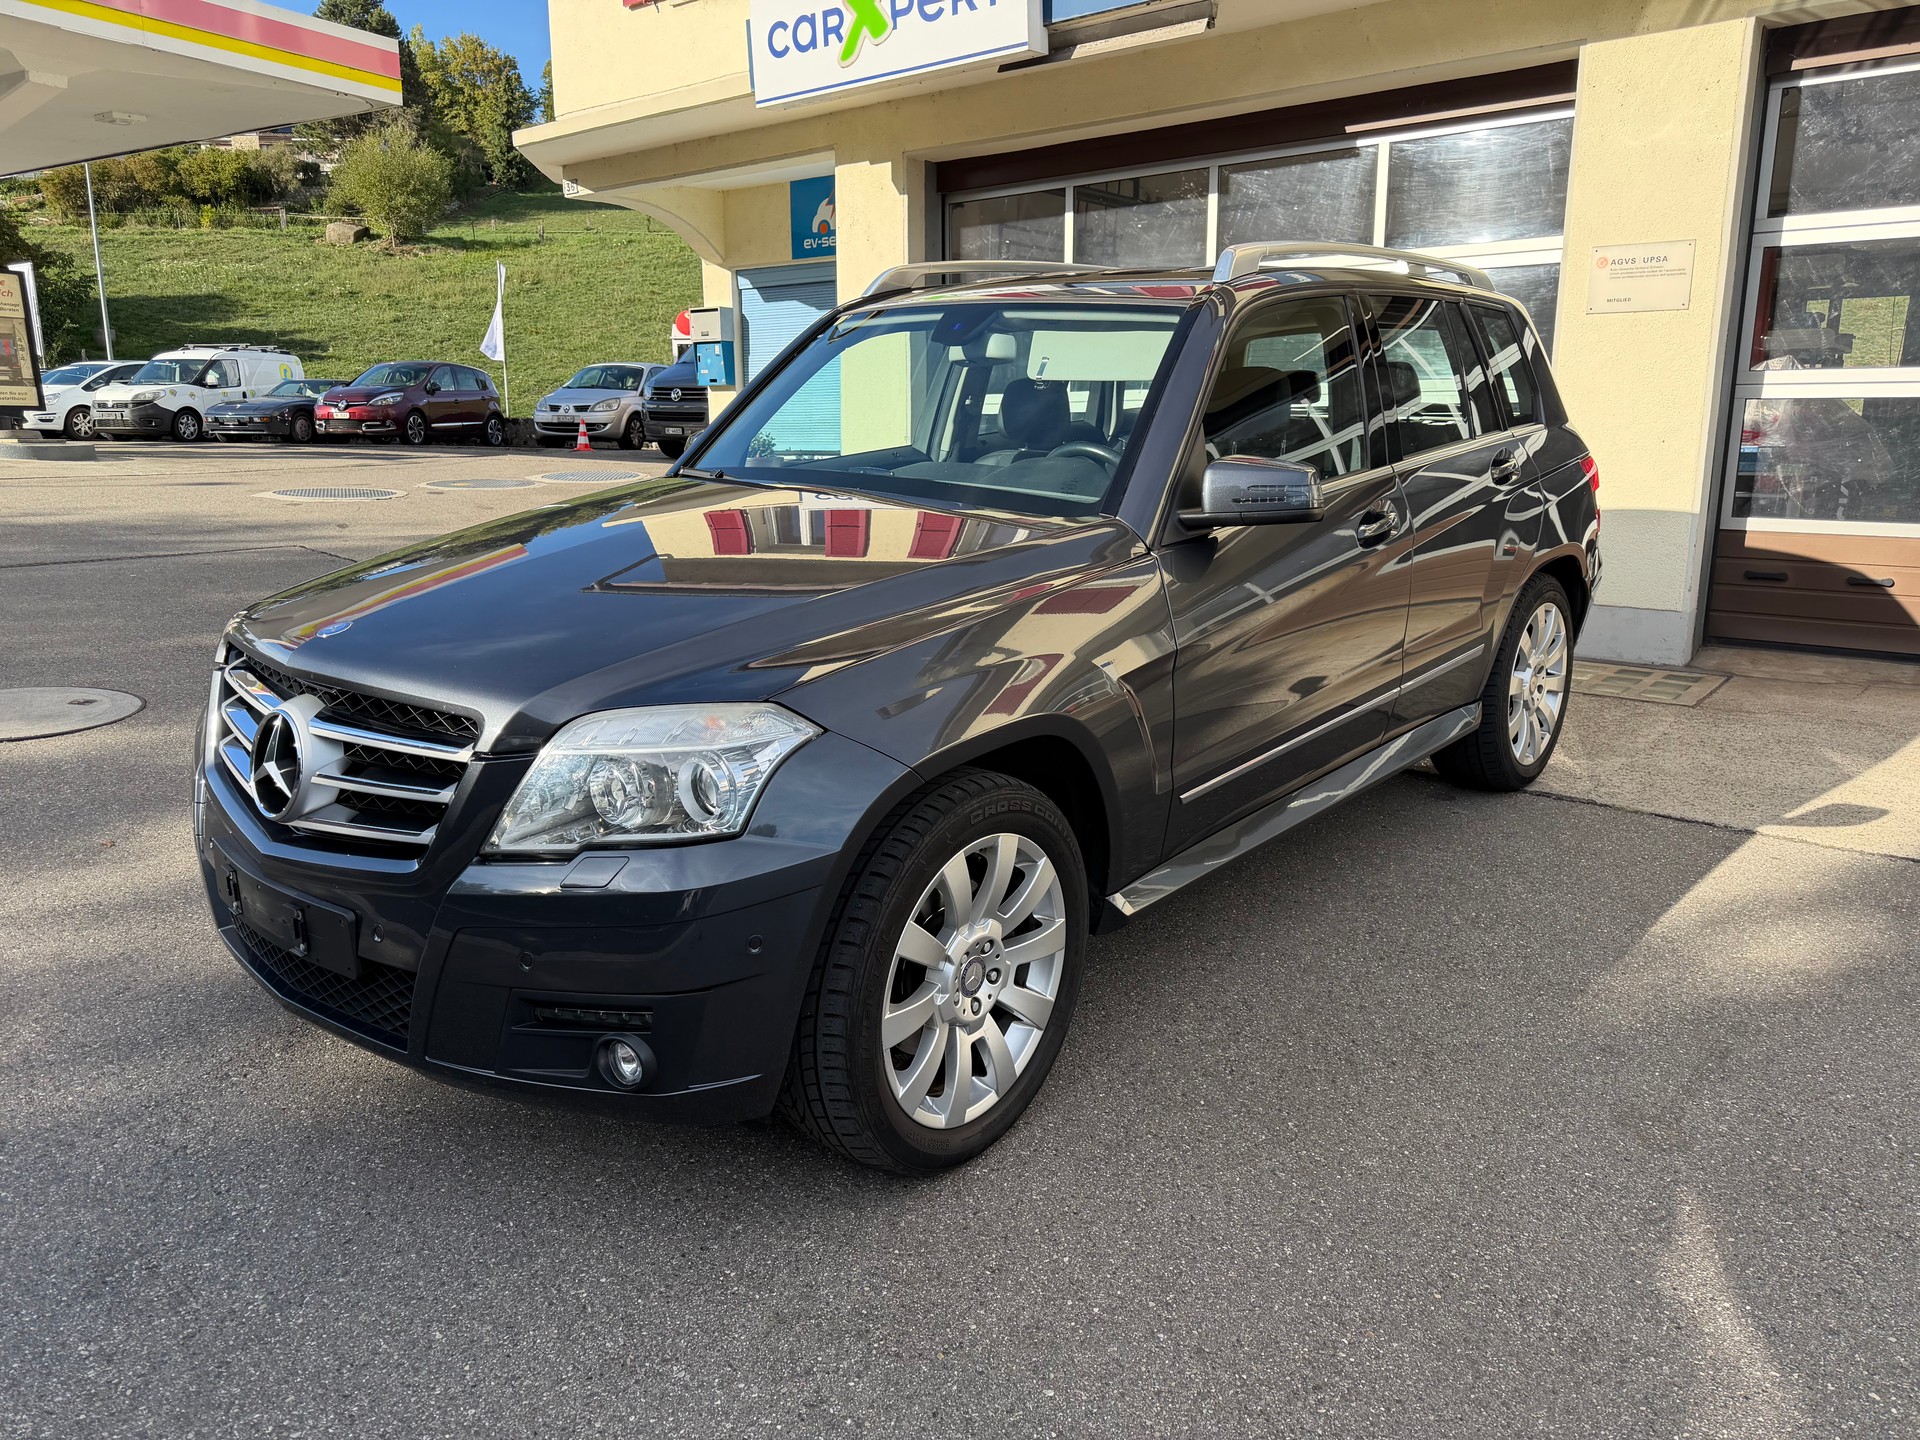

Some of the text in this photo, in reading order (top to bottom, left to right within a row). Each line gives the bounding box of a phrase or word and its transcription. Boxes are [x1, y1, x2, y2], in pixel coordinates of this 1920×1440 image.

[1610, 255, 1668, 266] AGVS UPSA
[970, 800, 1032, 825] CROSS
